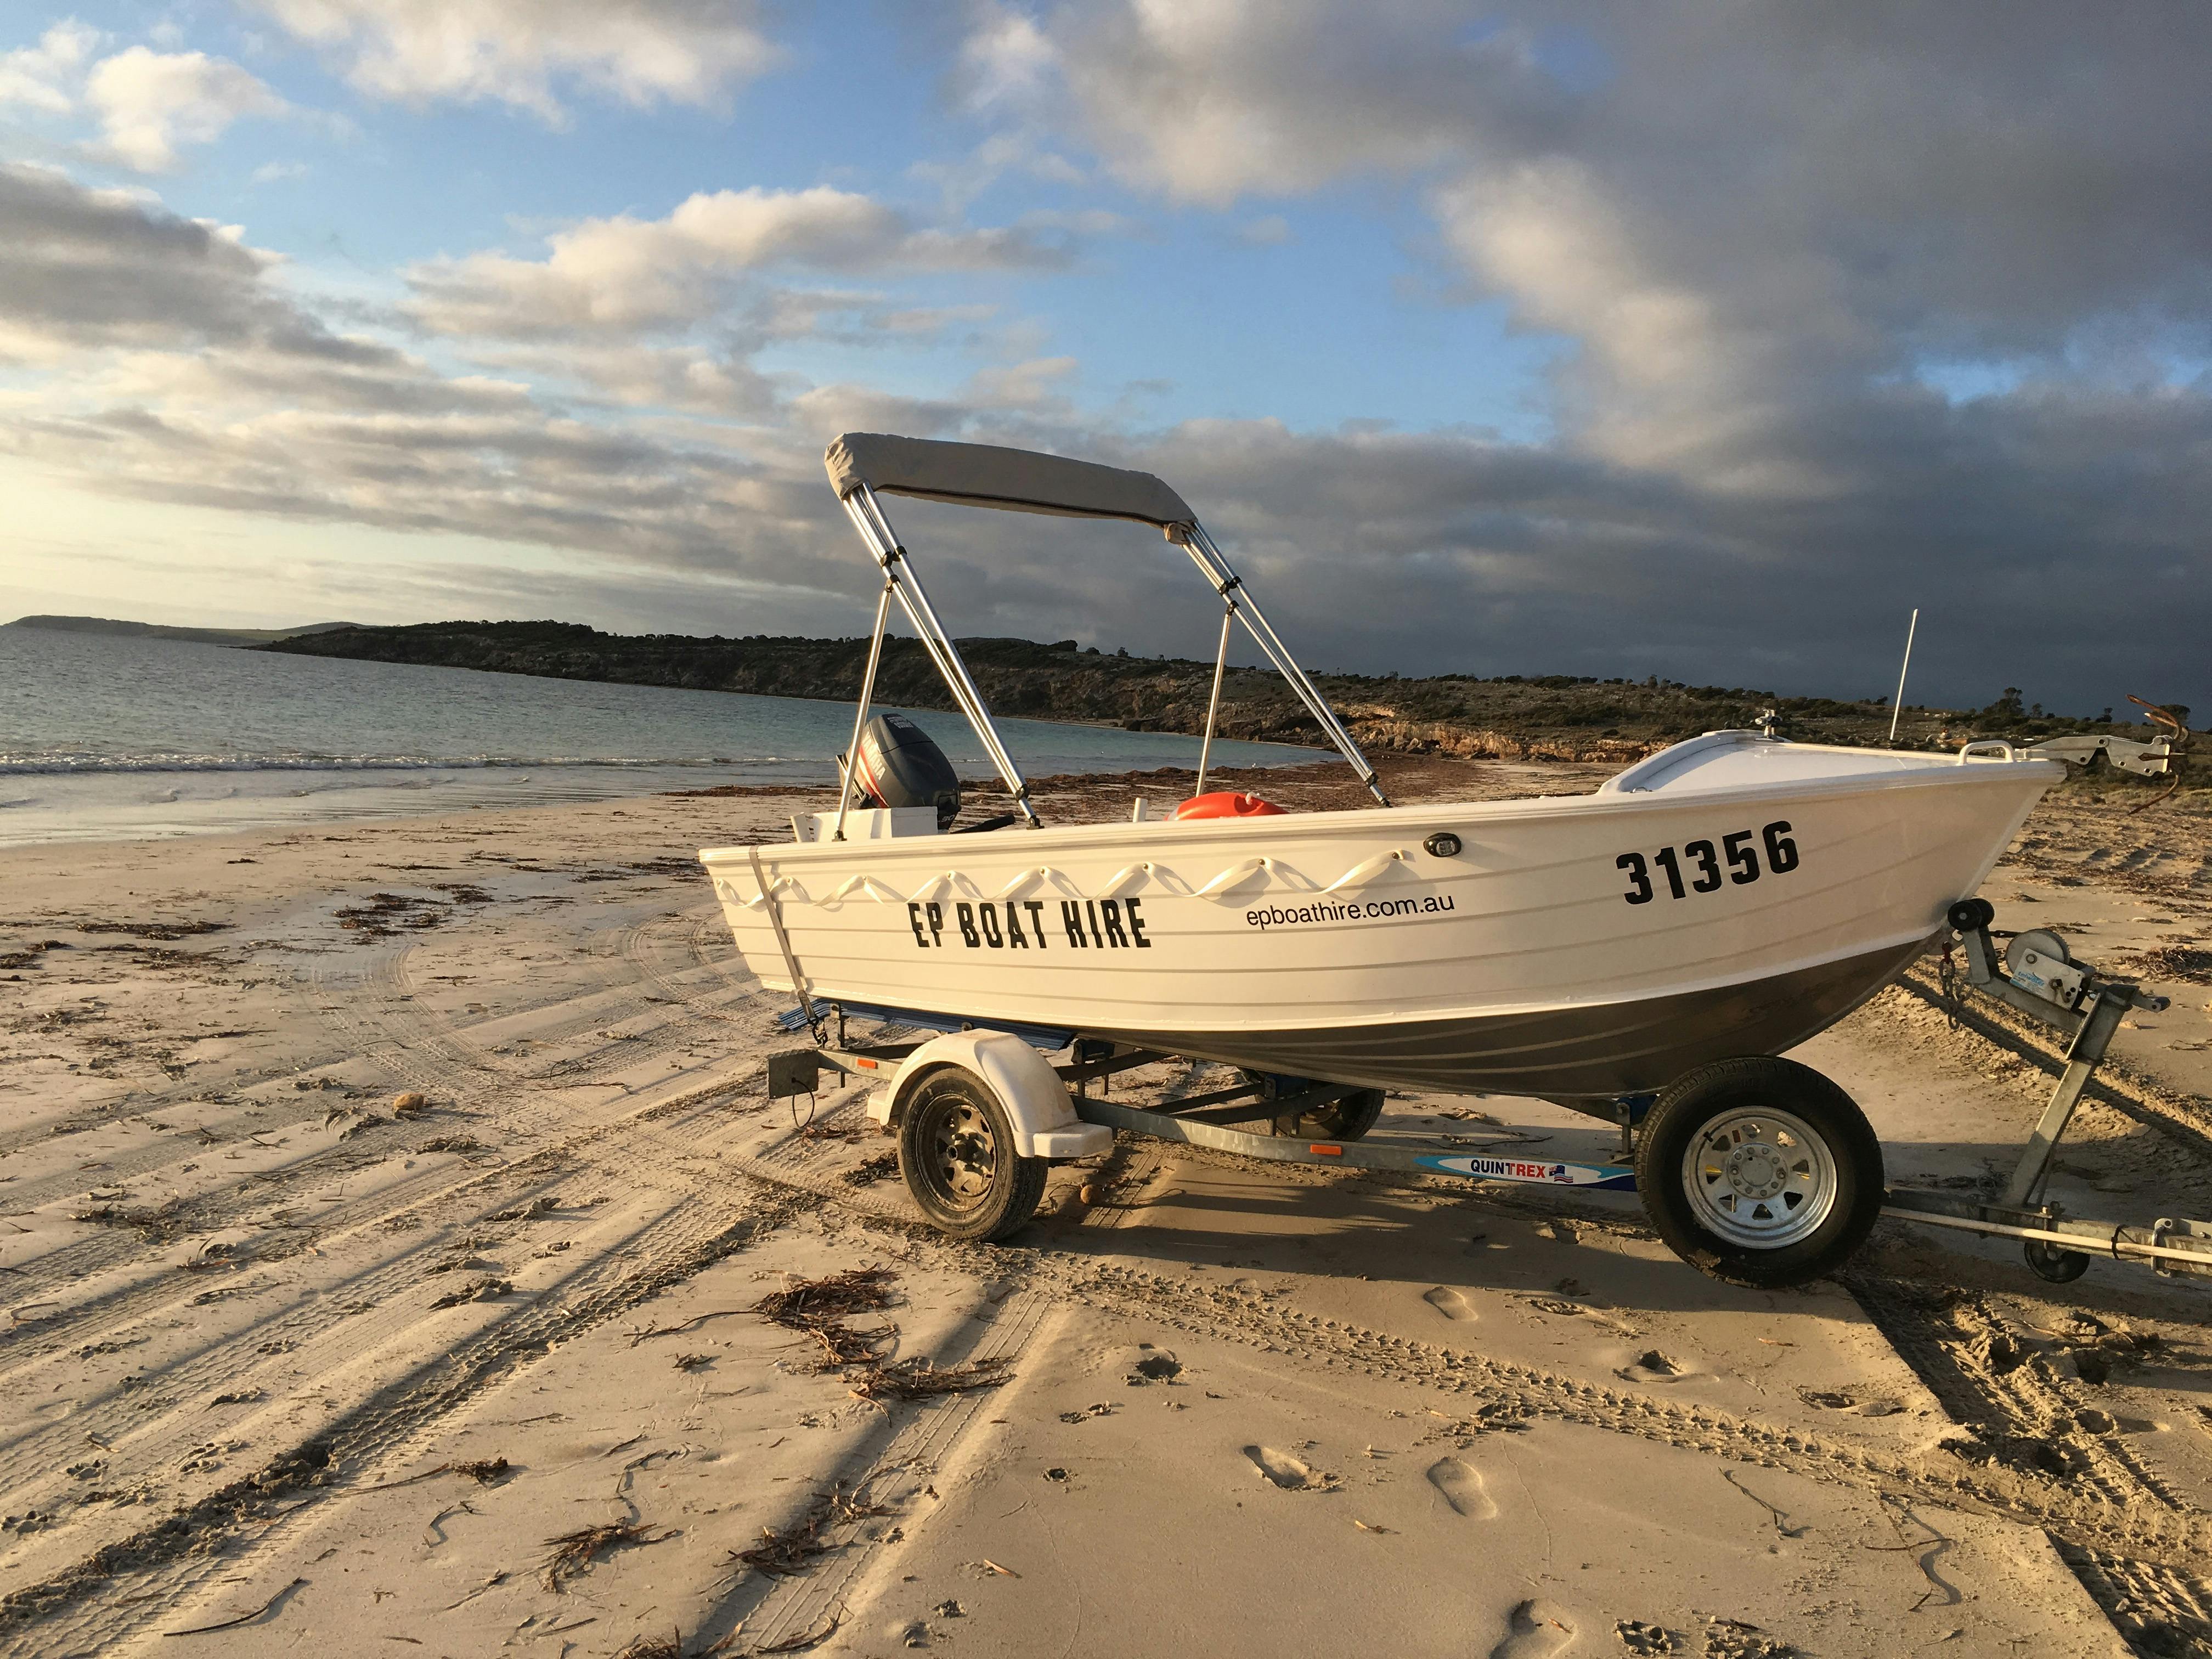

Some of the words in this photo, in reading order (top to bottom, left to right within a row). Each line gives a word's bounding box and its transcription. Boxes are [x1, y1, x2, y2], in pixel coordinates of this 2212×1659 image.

[861, 731, 886, 780] YAMAHA
[1616, 820, 1799, 905] 31356
[907, 902, 944, 947] EP
[956, 901, 1047, 949] BOAT
[1060, 898, 1152, 949] HIRE
[1246, 895, 1455, 930] epboathire.com.au
[1471, 1154, 1546, 1178] QUINTREX
